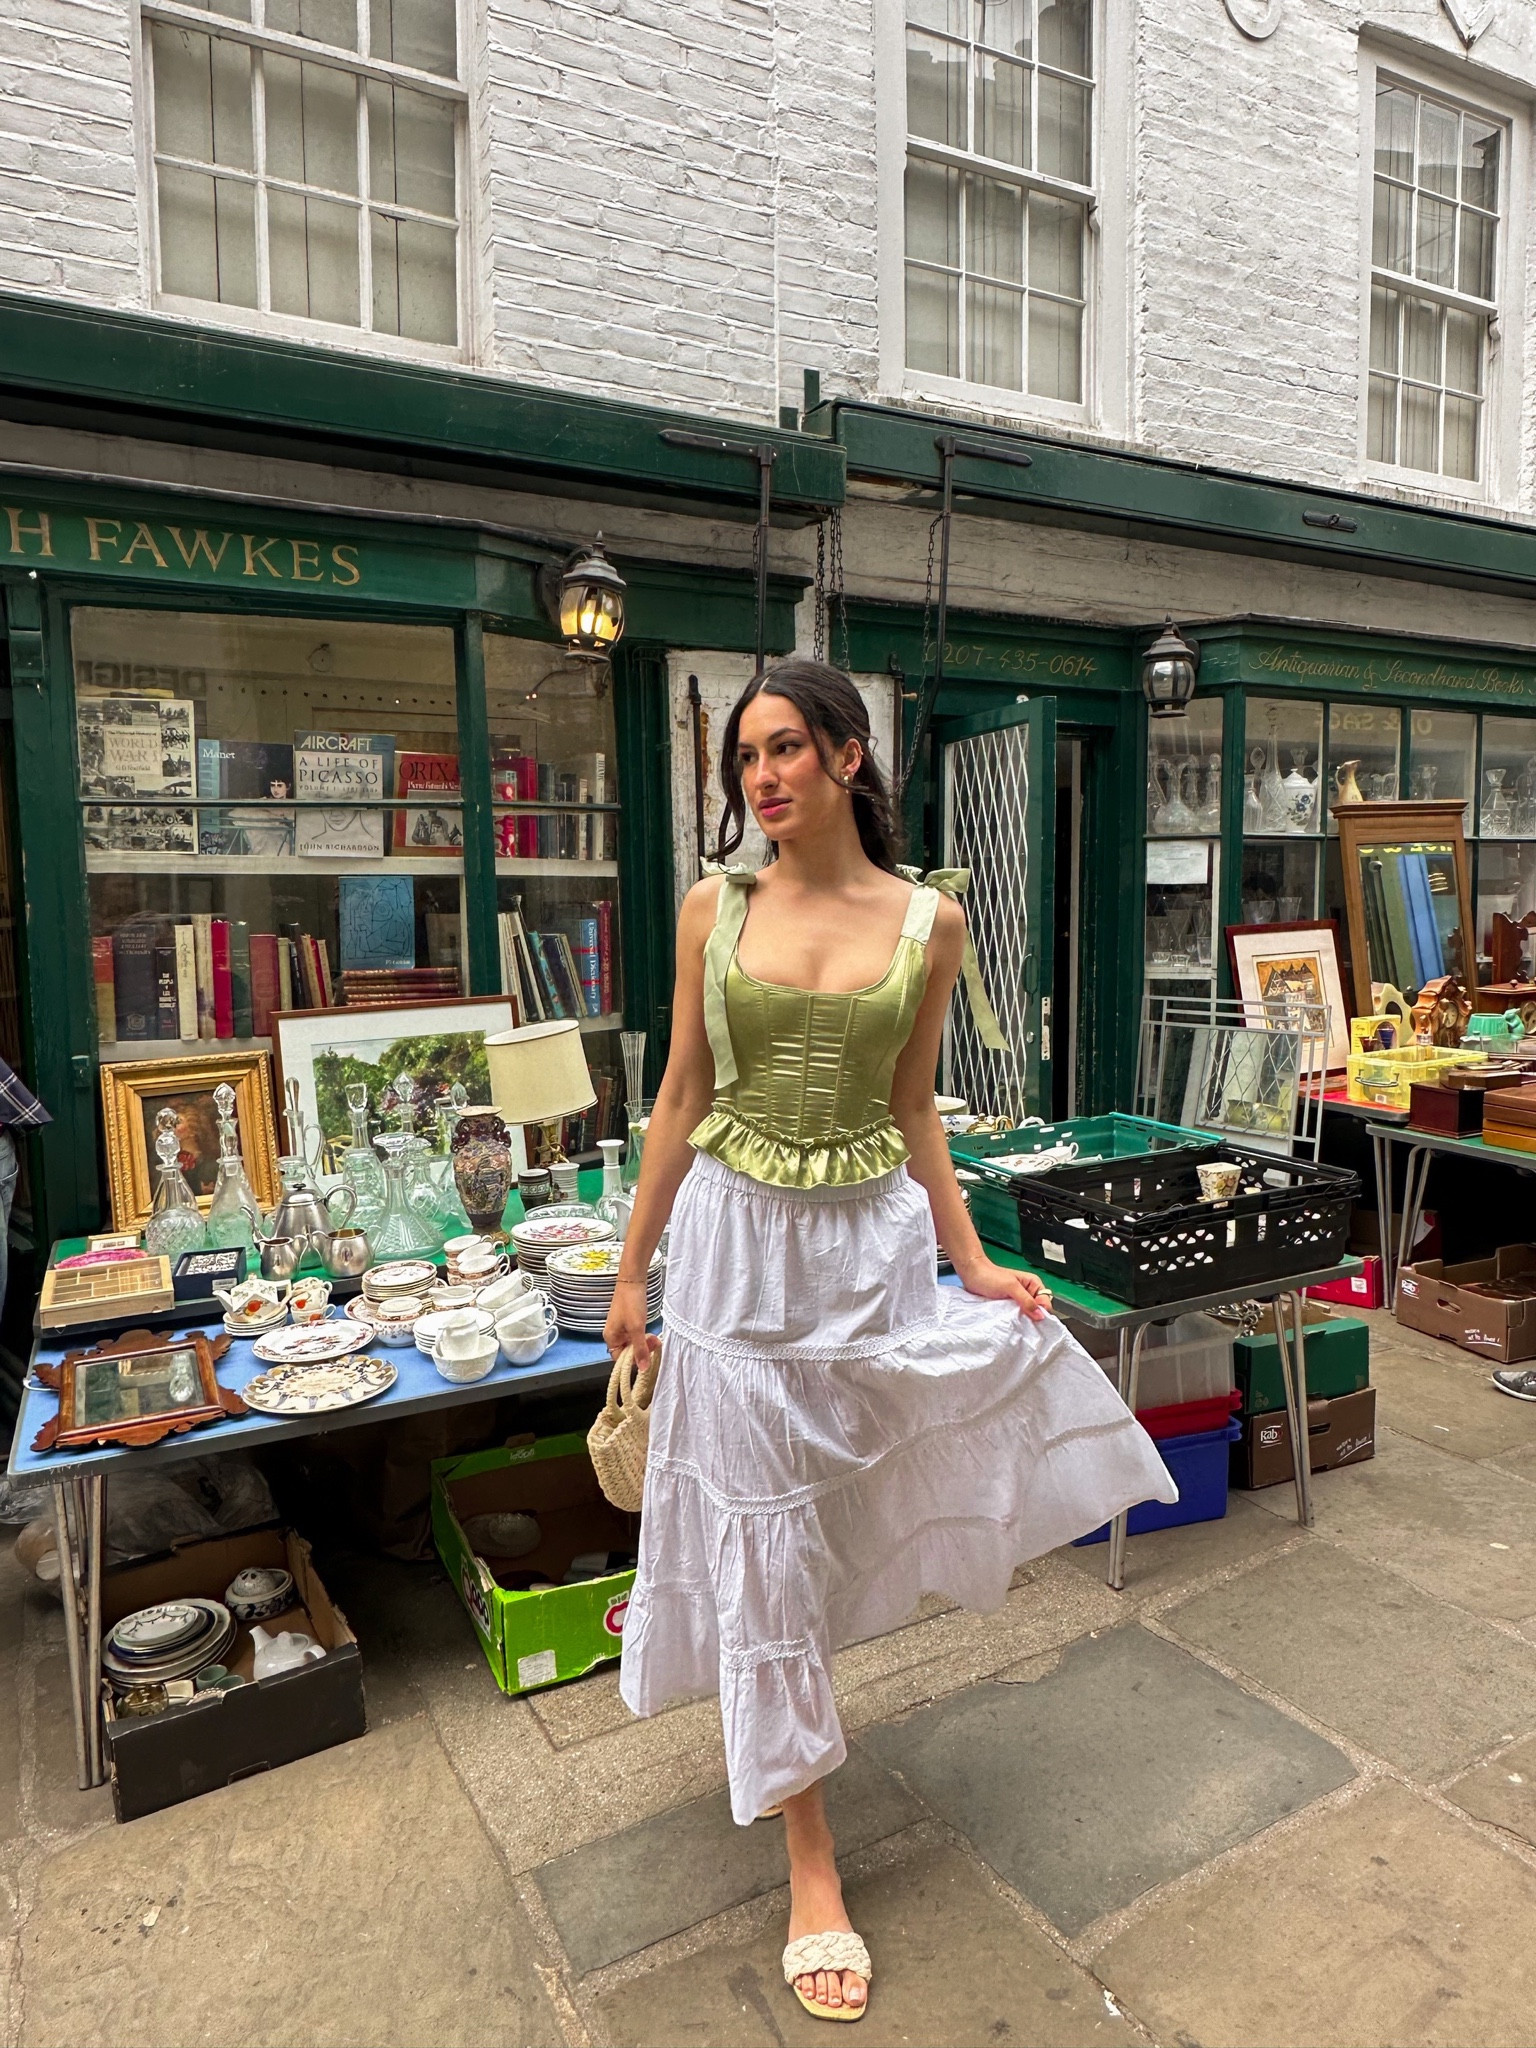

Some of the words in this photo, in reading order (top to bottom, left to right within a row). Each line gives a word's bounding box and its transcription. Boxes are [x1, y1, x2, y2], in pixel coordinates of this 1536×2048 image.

[3, 506, 55, 557] H
[84, 517, 361, 586] FAWKES
[1249, 645, 1359, 684] Antiquarian
[1379, 659, 1477, 690] Secondhand
[1476, 667, 1524, 695] Books
[109, 737, 158, 749] WORLD
[300, 735, 372, 752] AIRCRAFT
[110, 748, 147, 763] WAR
[299, 756, 308, 766] A
[318, 757, 350, 768] LIFE
[359, 758, 378, 769] OF
[299, 769, 378, 785] PICASSO
